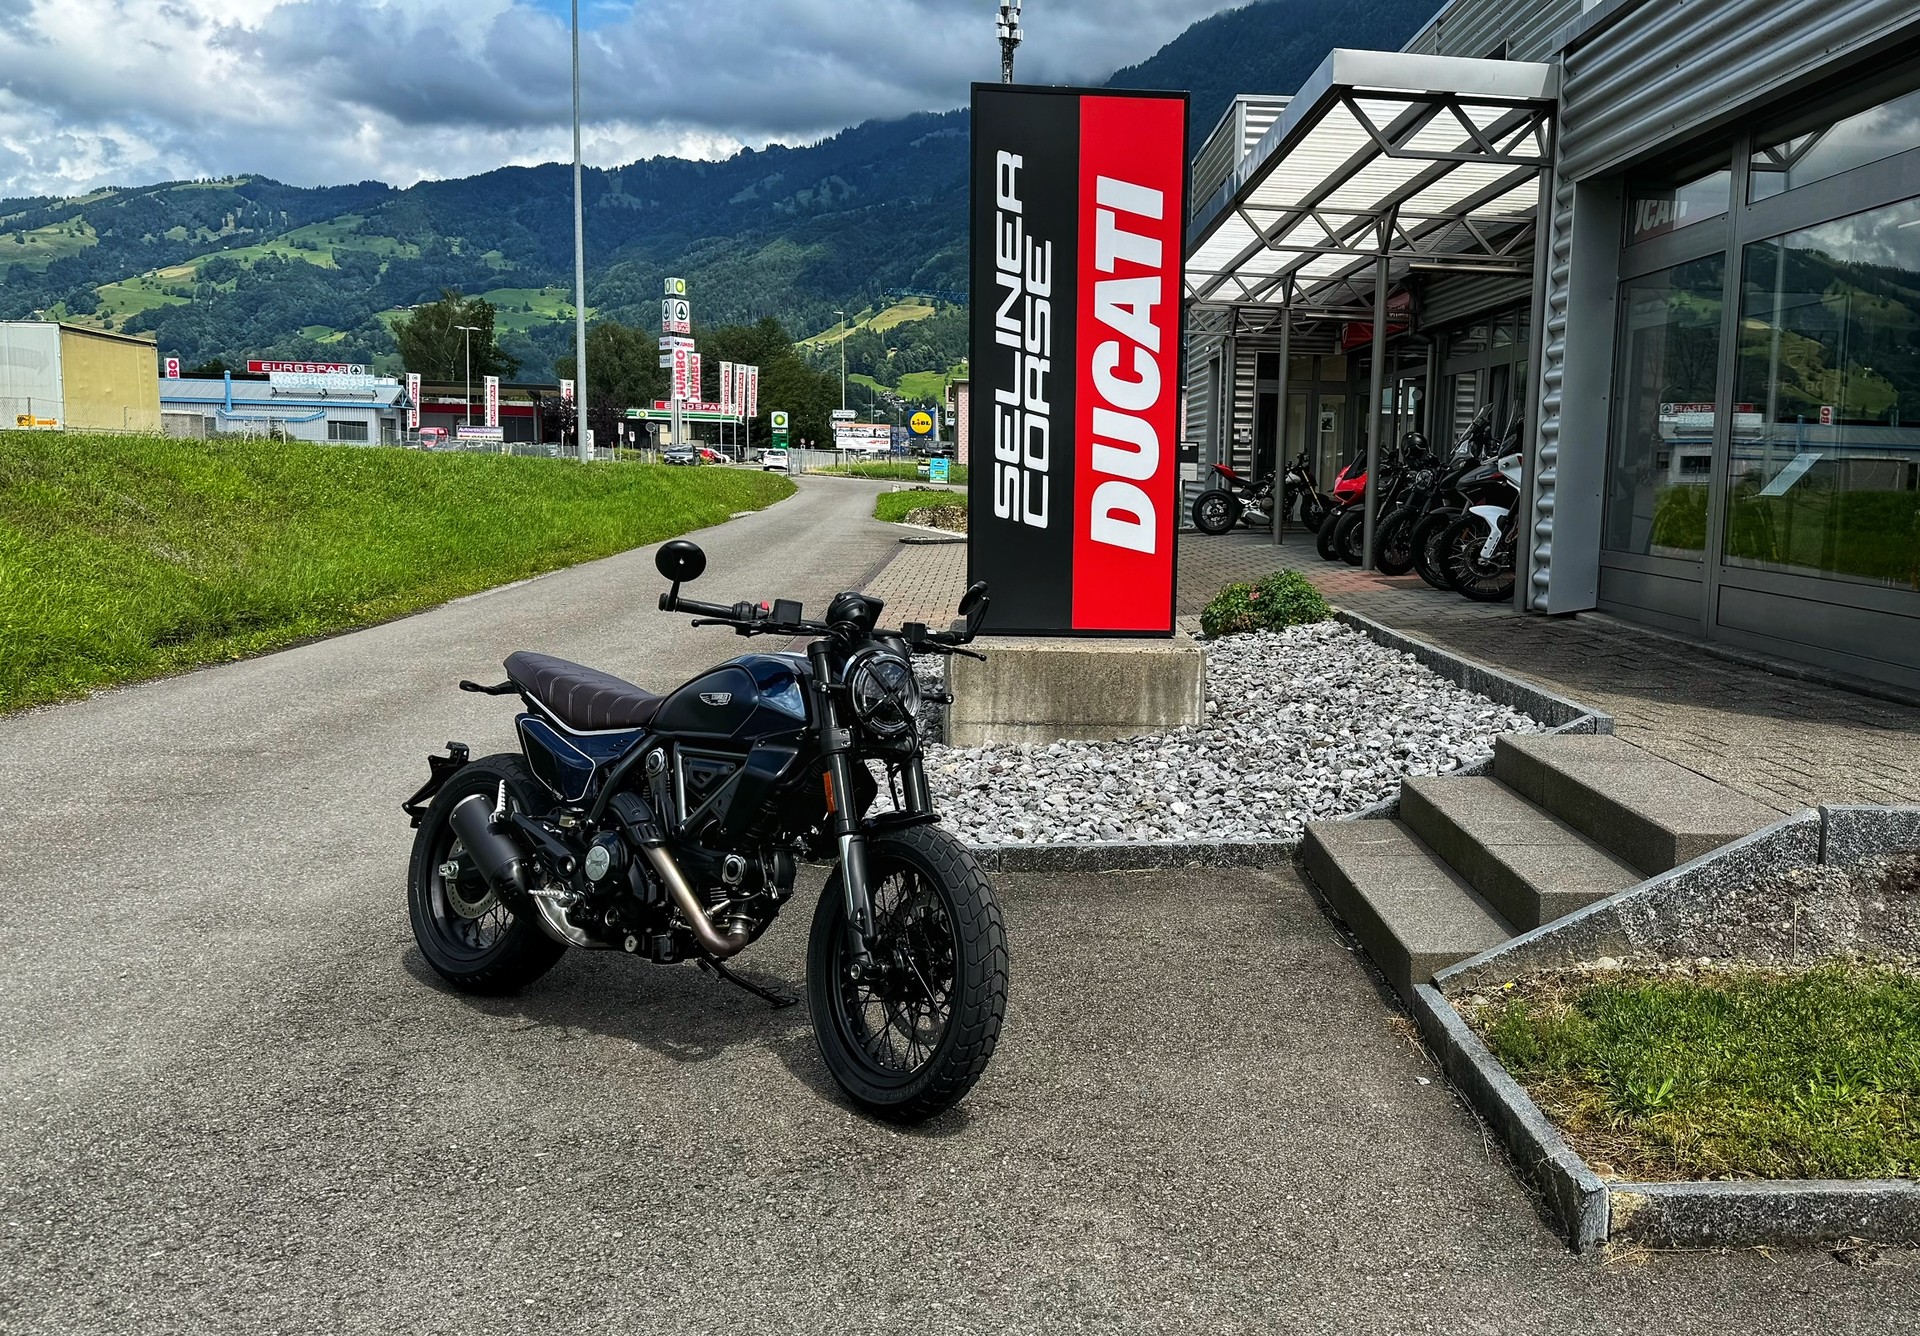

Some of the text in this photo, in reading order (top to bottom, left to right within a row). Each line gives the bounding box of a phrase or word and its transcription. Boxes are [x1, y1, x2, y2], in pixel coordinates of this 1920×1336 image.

[261, 363, 348, 373] EUROSPAR
[676, 350, 686, 397] JUMBO
[690, 355, 699, 400] JUMBO
[994, 149, 1023, 523] SELINER
[1023, 235, 1052, 529] CORSE
[1090, 175, 1164, 555] DUCATI
